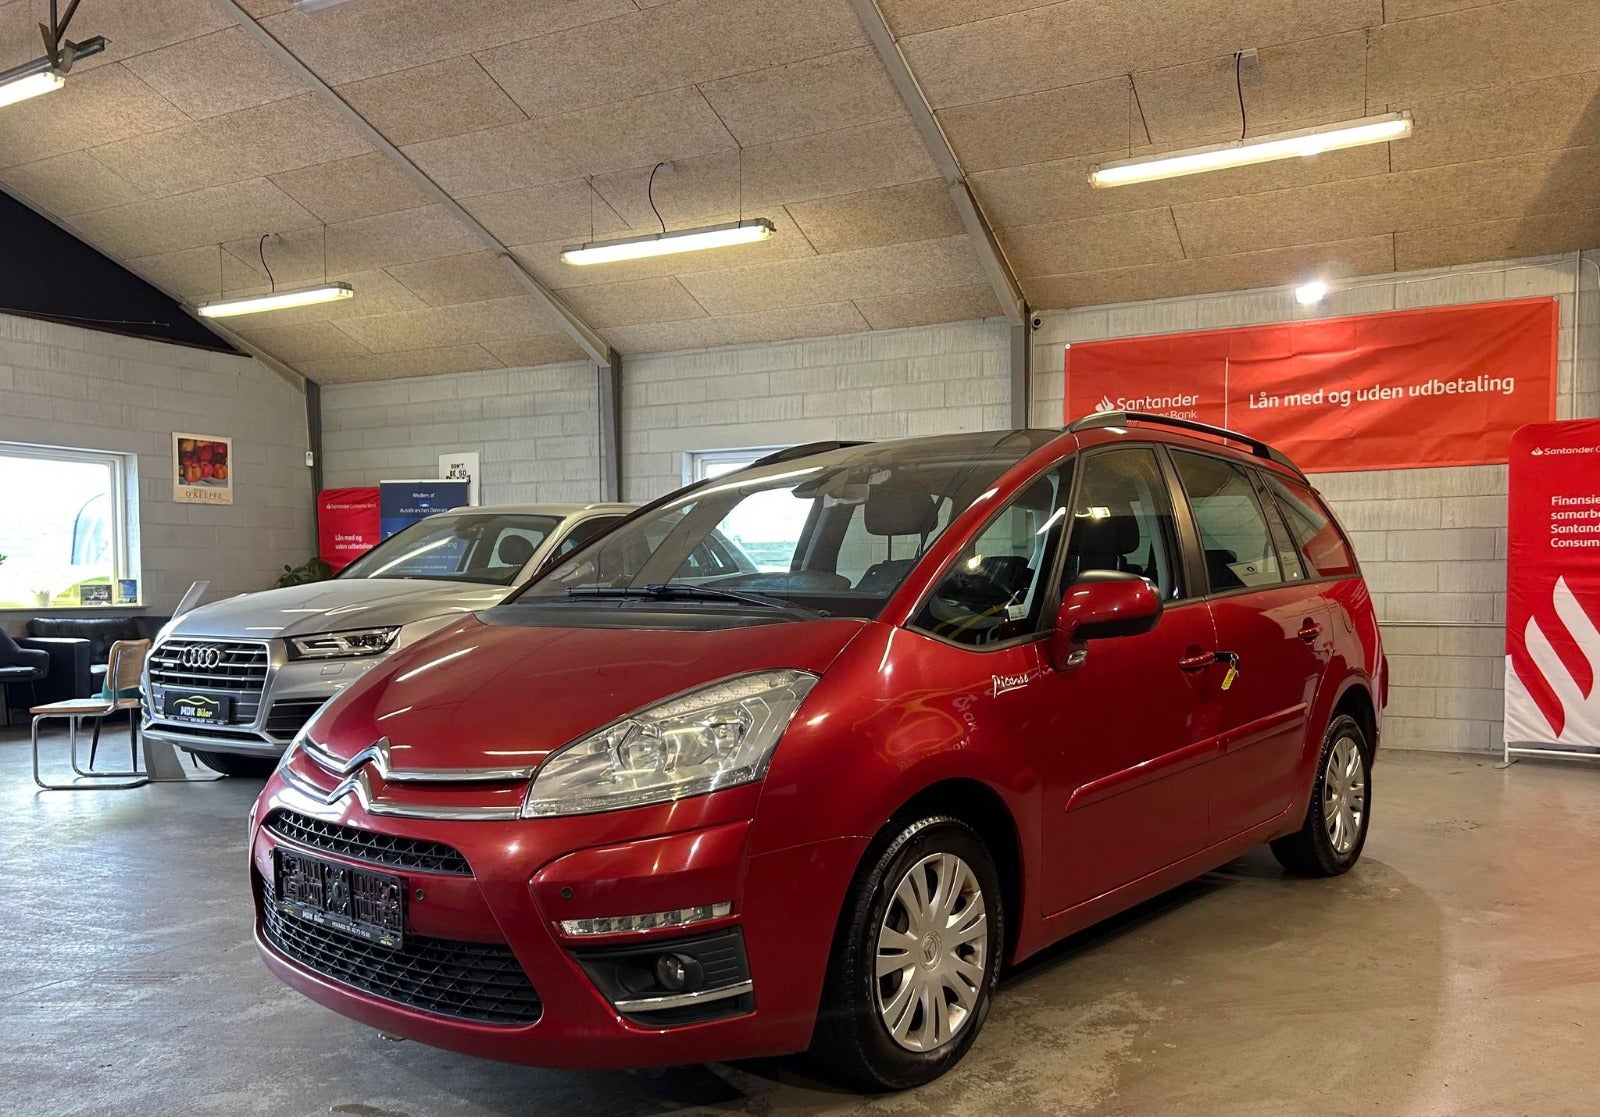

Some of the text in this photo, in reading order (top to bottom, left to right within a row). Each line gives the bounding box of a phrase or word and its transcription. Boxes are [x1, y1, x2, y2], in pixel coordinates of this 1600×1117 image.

[1249, 375, 1515, 409] Lån med og uden udbetaling
[1117, 394, 1199, 411] Santander
[1170, 410, 1198, 419] Bank
[1544, 446, 1595, 455] Santander
[1551, 508, 1600, 520] samarb
[335, 533, 345, 541] Lån
[1550, 537, 1600, 548] Consum
[991, 674, 1029, 698] Picasso
[181, 706, 196, 716] MDK
